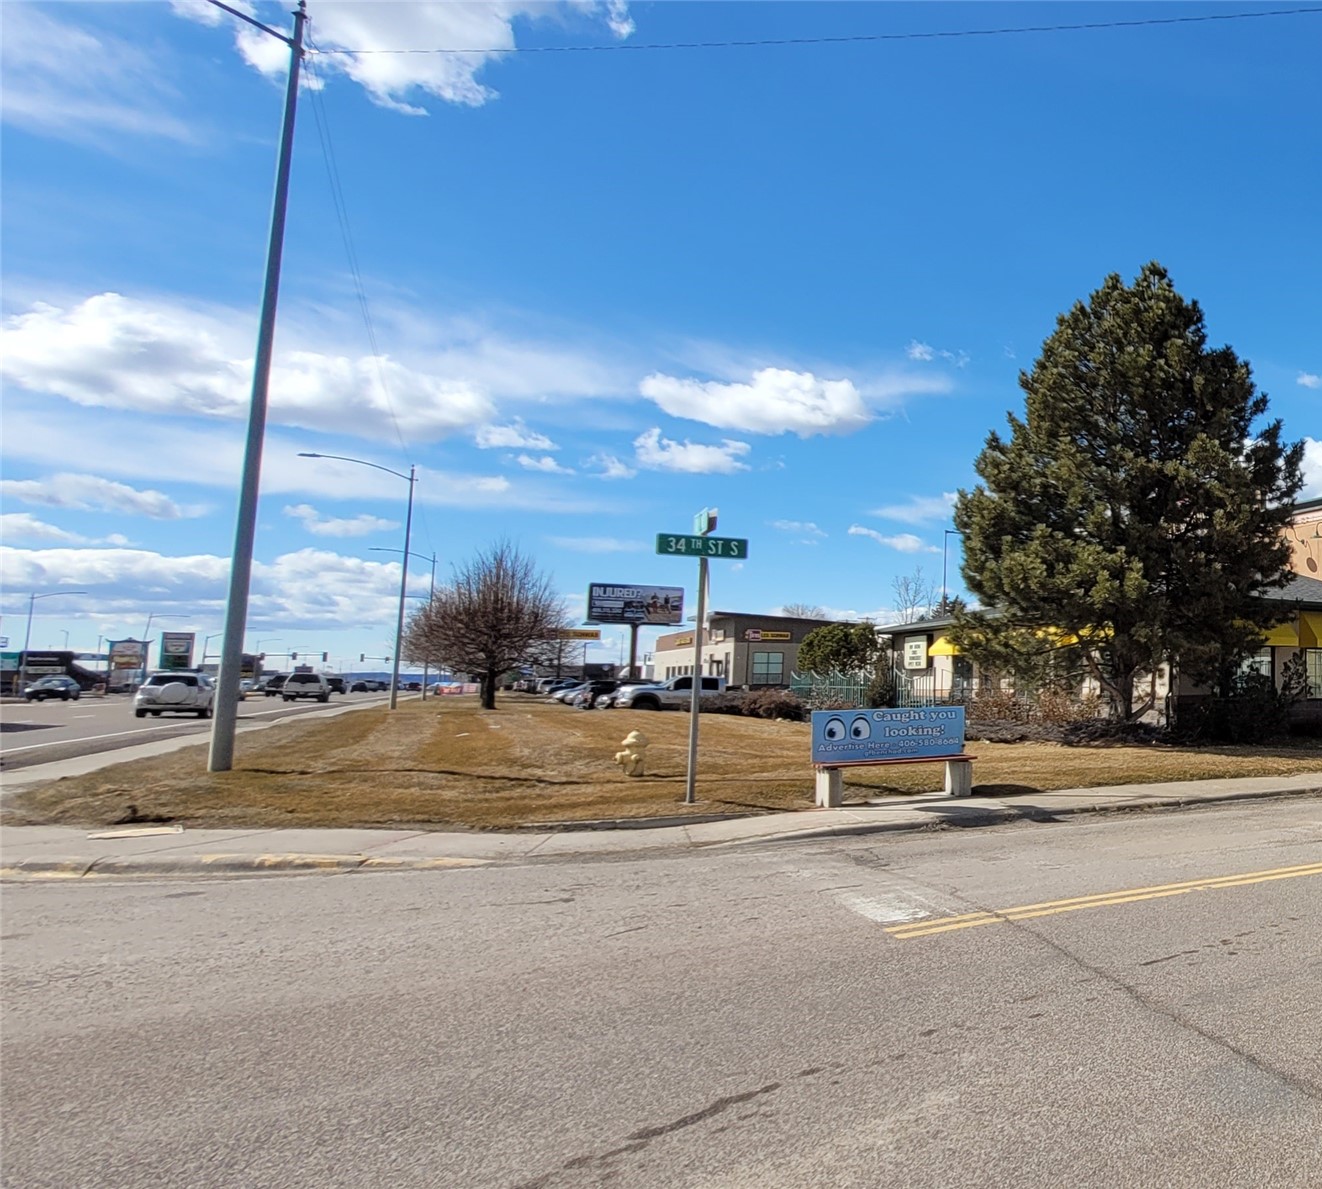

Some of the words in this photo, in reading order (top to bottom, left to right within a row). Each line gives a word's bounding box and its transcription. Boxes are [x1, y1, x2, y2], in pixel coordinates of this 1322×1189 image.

[666, 537, 686, 552] 34
[691, 538, 703, 549] TH
[708, 540, 724, 555] ST
[730, 541, 739, 556] S
[592, 586, 642, 599] INJURED?
[872, 710, 926, 723] Caught
[930, 710, 957, 721] you
[884, 724, 946, 738] looking!
[818, 743, 865, 752] Advertise
[867, 741, 890, 750] Here
